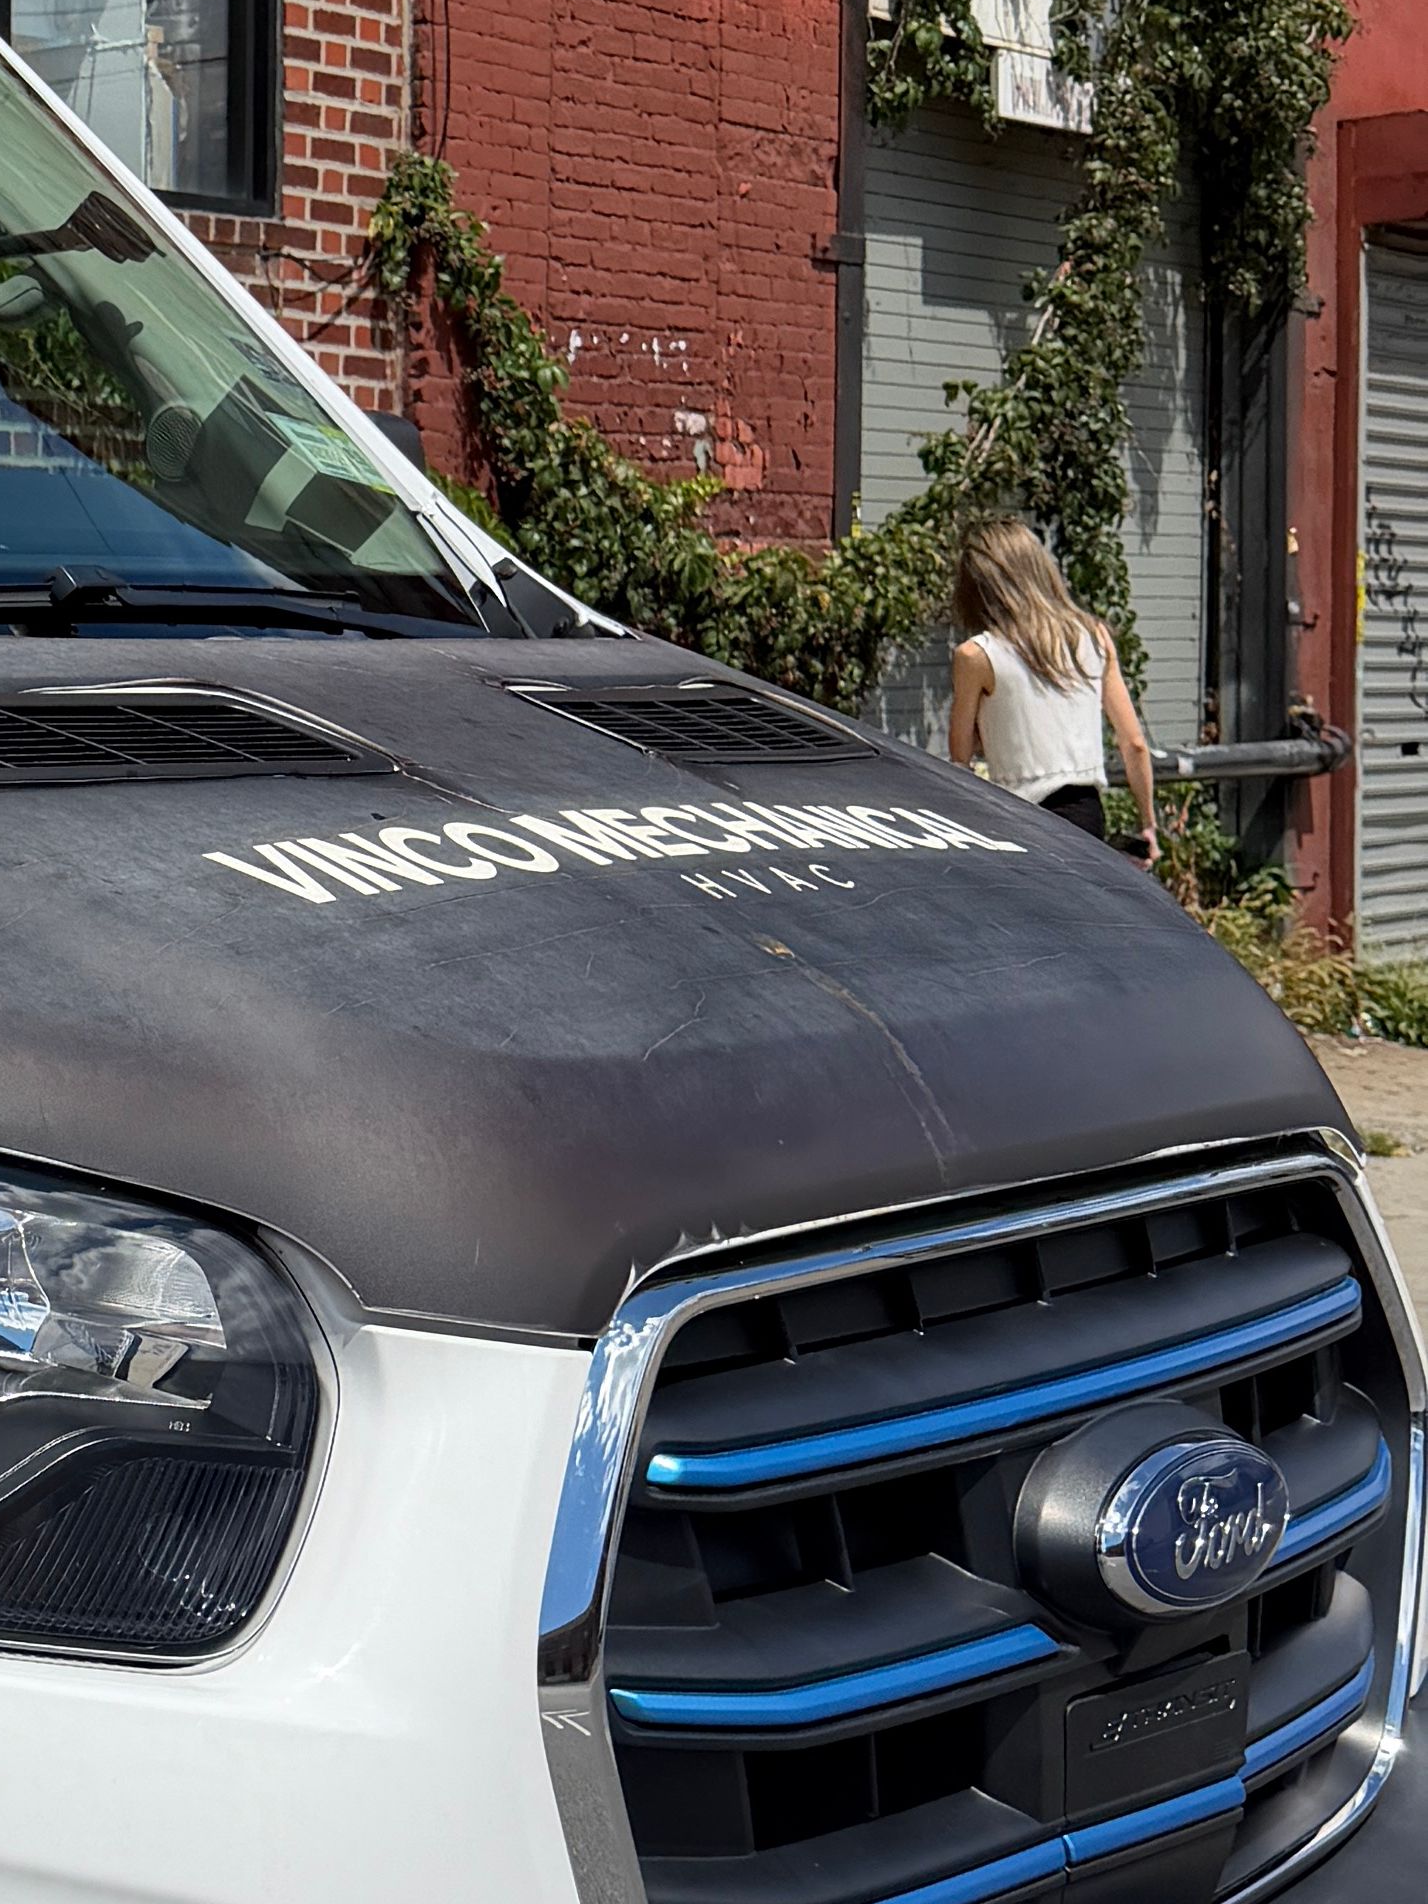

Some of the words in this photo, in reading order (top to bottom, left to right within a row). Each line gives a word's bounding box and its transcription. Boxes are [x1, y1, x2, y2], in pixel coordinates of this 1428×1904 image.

[200, 821, 560, 905] VINCO
[508, 801, 1029, 867] MECHANICAL
[680, 862, 856, 900] HVAC
[1174, 1467, 1274, 1580] Ford
